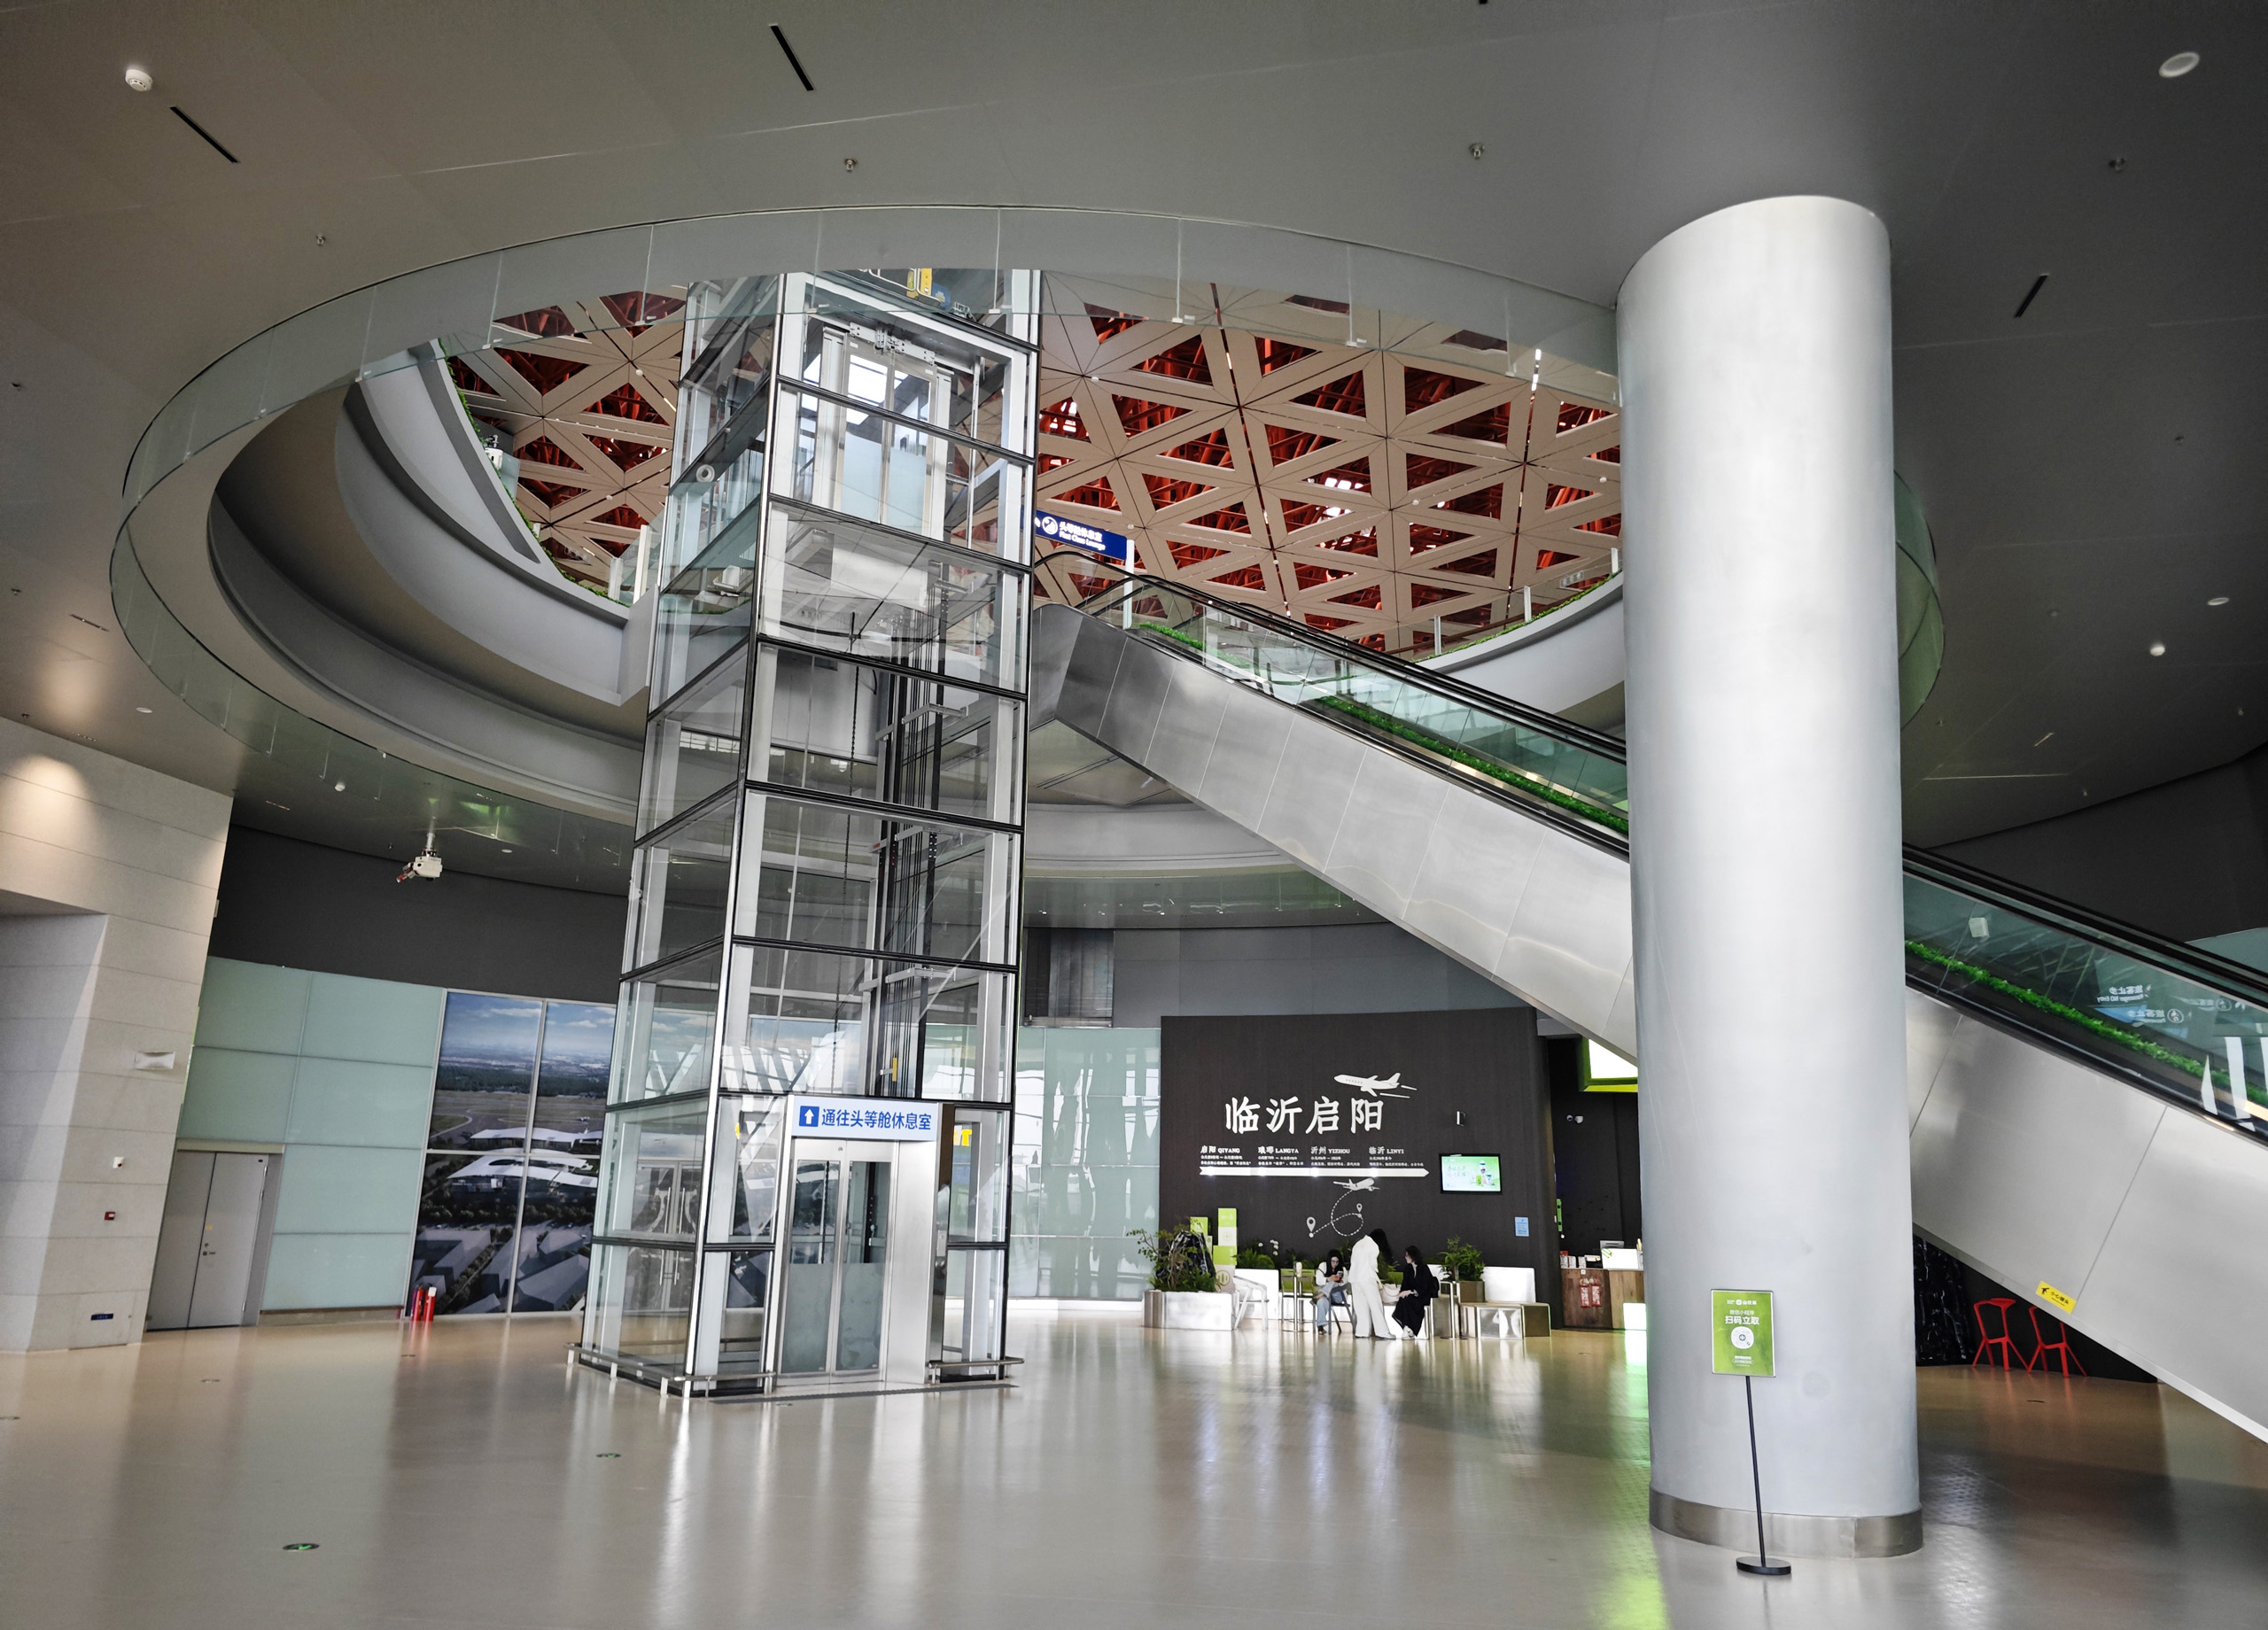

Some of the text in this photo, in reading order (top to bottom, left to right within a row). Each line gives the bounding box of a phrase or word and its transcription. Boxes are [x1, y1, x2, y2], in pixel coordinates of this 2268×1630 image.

[821, 1108, 932, 1130] 通往头等舱休息室
[1225, 1096, 1384, 1135] 临沂启阳
[1725, 1316, 1759, 1325] 扫码立取
